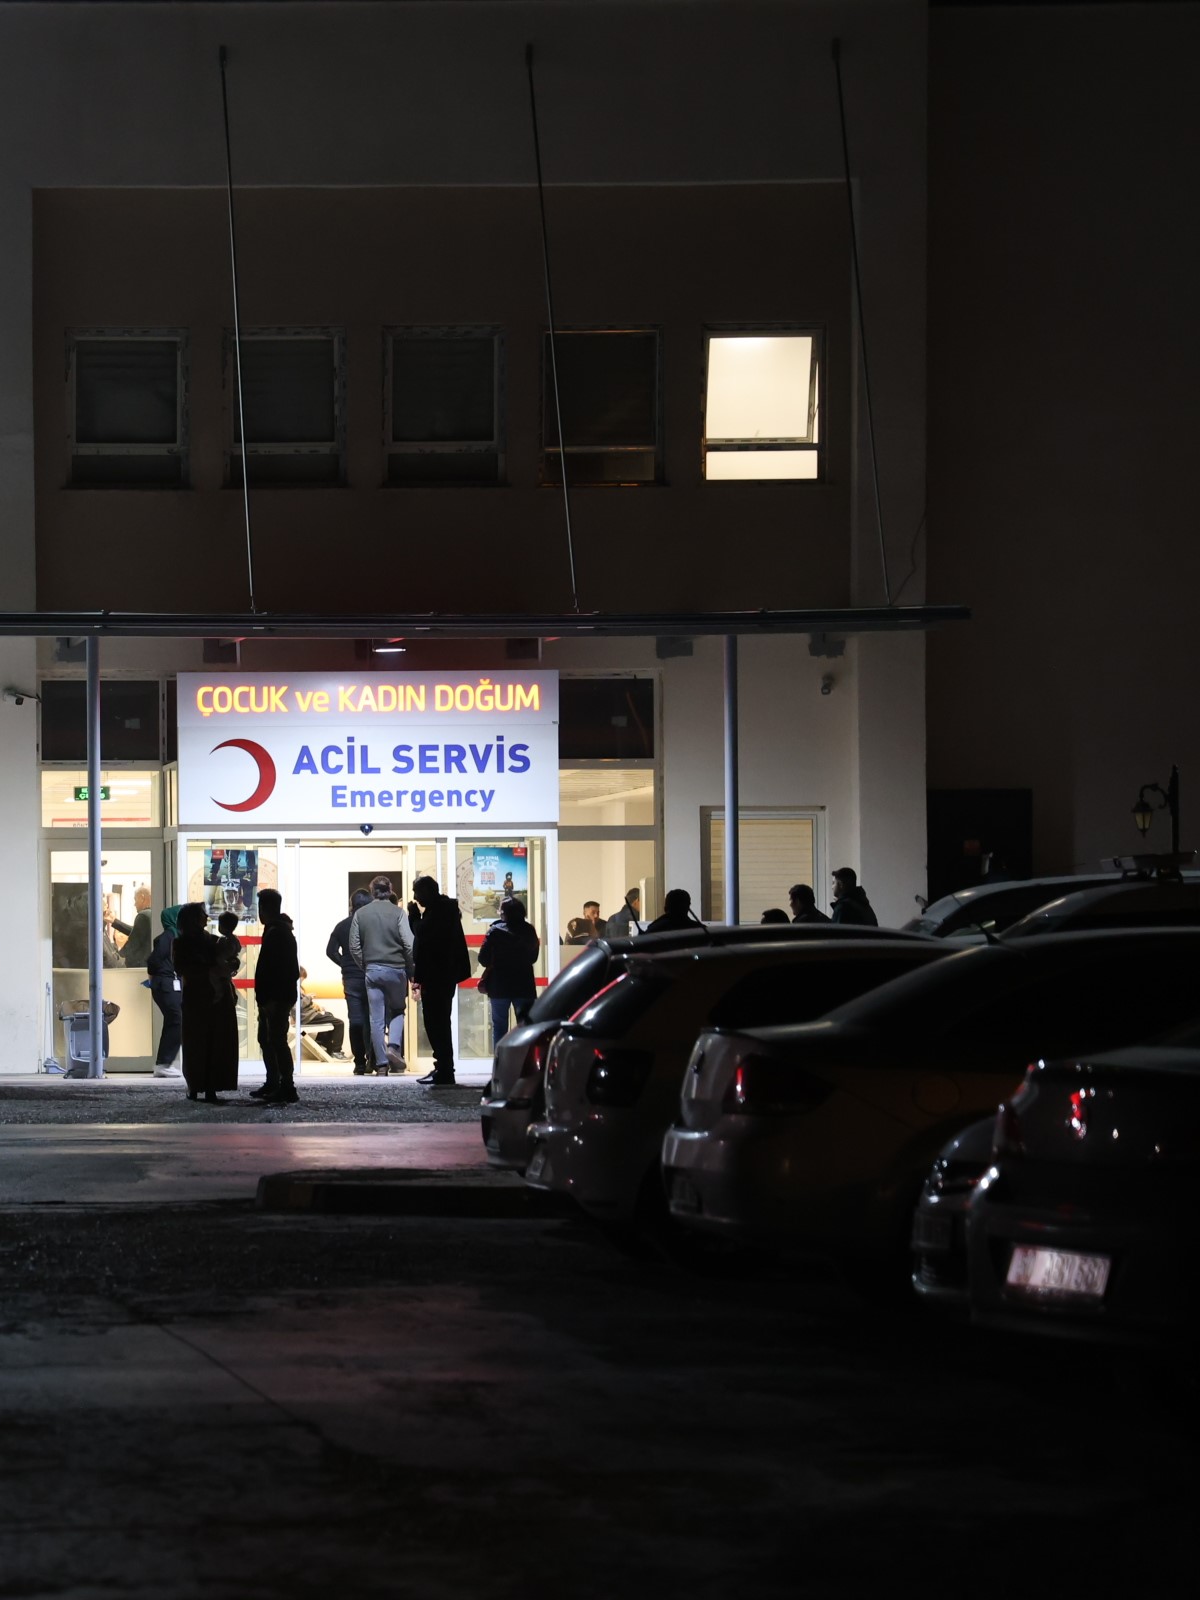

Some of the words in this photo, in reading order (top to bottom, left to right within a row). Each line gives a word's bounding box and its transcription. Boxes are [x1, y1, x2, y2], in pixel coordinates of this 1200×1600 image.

[197, 685, 288, 716] ÇOCUK
[295, 691, 330, 712] ve
[339, 685, 425, 712] KADIN
[435, 679, 540, 712] DOĞUM
[292, 736, 381, 774] ACİL
[392, 735, 531, 774] SERVİS
[331, 785, 495, 812] Emergency
